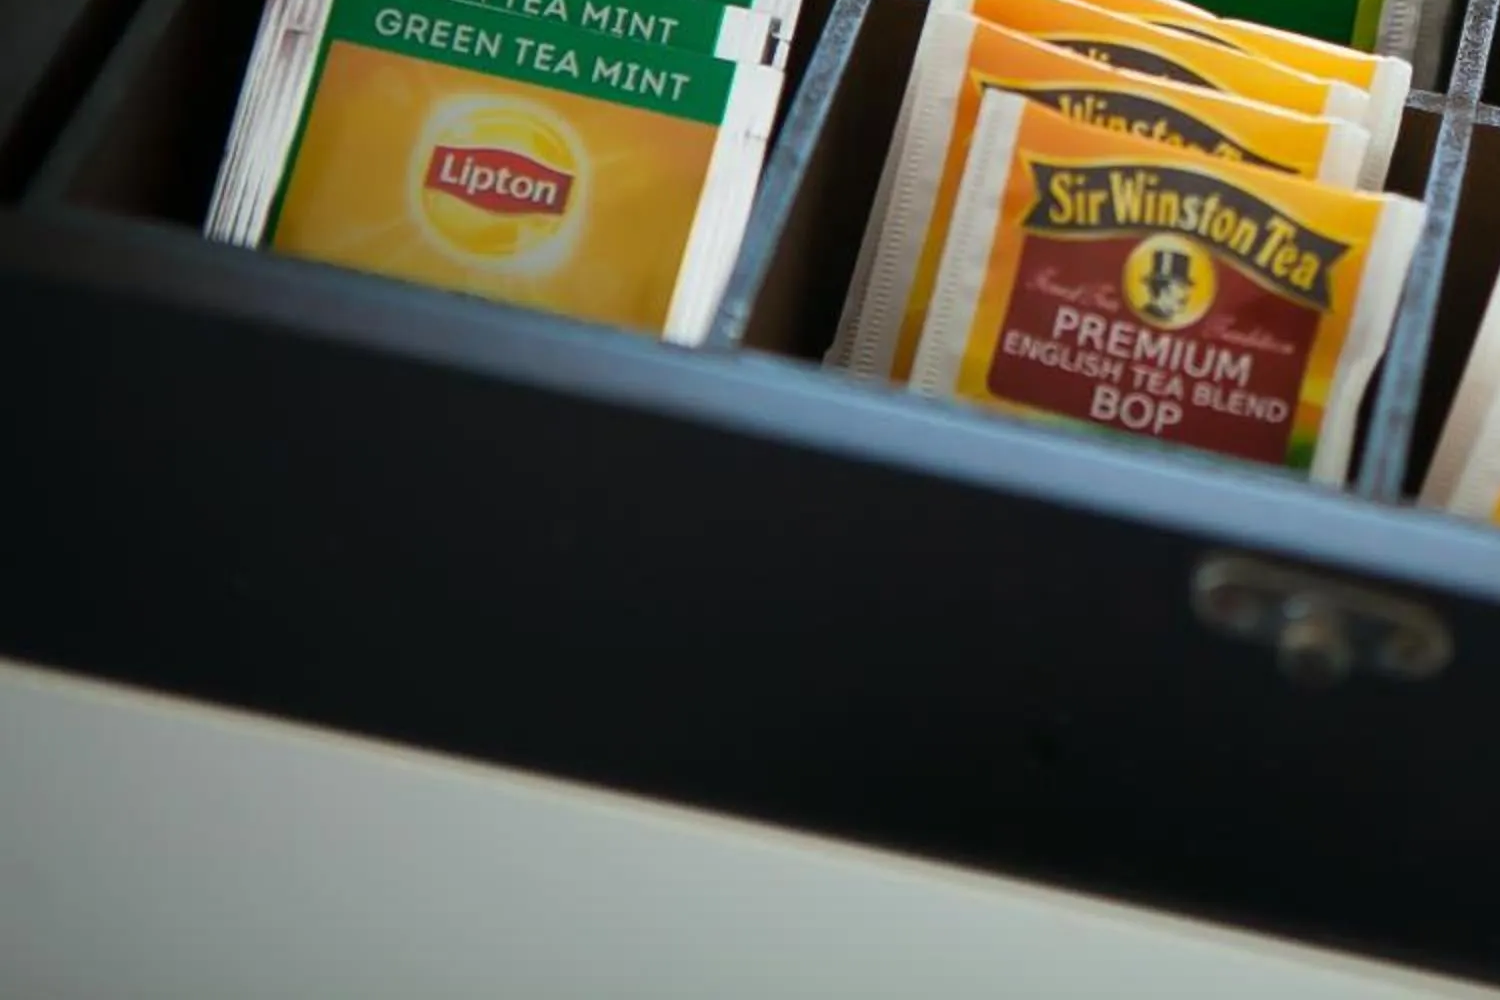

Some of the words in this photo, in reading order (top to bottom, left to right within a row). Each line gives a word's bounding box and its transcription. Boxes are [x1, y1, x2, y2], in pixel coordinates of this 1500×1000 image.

[374, 7, 502, 59] GREEN
[514, 37, 579, 77] TEA
[591, 57, 690, 102] MINT
[581, 1, 680, 44] MINT
[439, 154, 559, 206] Lipton
[1049, 171, 1110, 225] Sir
[1109, 171, 1258, 255] Winston
[1256, 218, 1321, 291] Tea
[1003, 329, 1124, 384] ENGLISH
[1130, 364, 1185, 401] TEA
[1191, 380, 1290, 424] BLEND
[1052, 305, 1253, 388] PREMIUM
[1090, 384, 1184, 435] BOP
